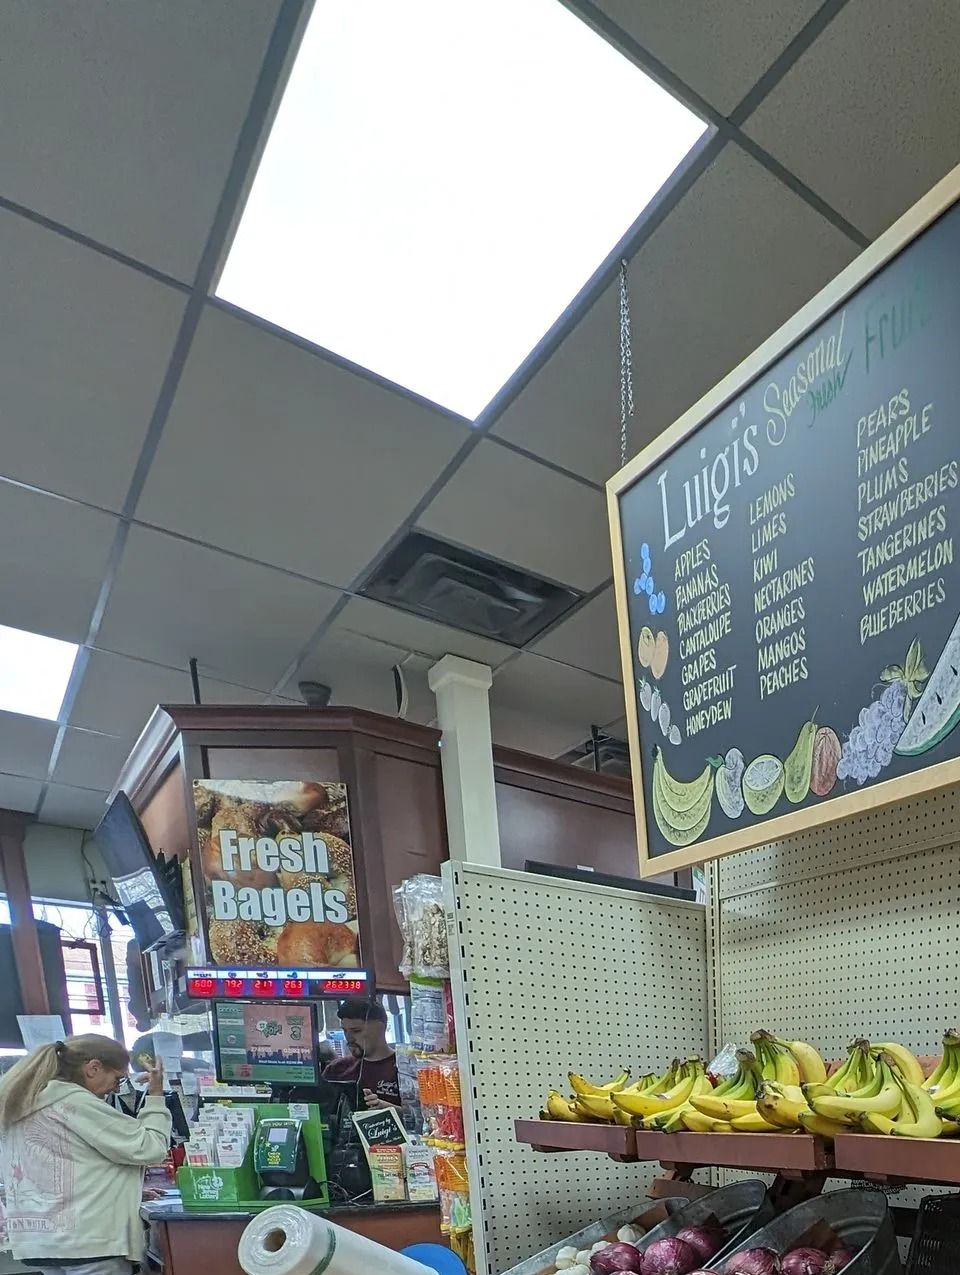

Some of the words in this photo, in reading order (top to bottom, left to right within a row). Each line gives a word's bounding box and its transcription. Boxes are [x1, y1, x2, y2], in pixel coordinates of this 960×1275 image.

[657, 401, 760, 552] Luigi's
[763, 309, 847, 446] Seasonal
[857, 388, 910, 448] PEARS
[857, 403, 933, 477] PINEAPPLE
[750, 473, 795, 525] LEMONS
[857, 460, 958, 542] STRAWBERRIES
[858, 457, 909, 512] PLUMS
[751, 512, 787, 554] LIMES
[857, 505, 947, 576] TANGERINES
[675, 538, 711, 581] APPLES
[753, 548, 778, 583] KIWI
[863, 538, 953, 606] WATERMELON
[675, 563, 719, 611] BANANAS
[754, 556, 815, 614] NECTARINES
[755, 597, 806, 644] ORANGES
[859, 577, 946, 645] BLUEBERRIES
[679, 611, 732, 660] CANTALOUPE
[758, 627, 806, 672] MANGOS
[681, 648, 717, 685] GRAPES
[683, 664, 737, 711] GRAPEFRUIT
[760, 656, 808, 700] PEACHES
[686, 697, 732, 737] HONEYDEW
[218, 829, 329, 873] Fresh
[211, 879, 348, 927] Bagels
